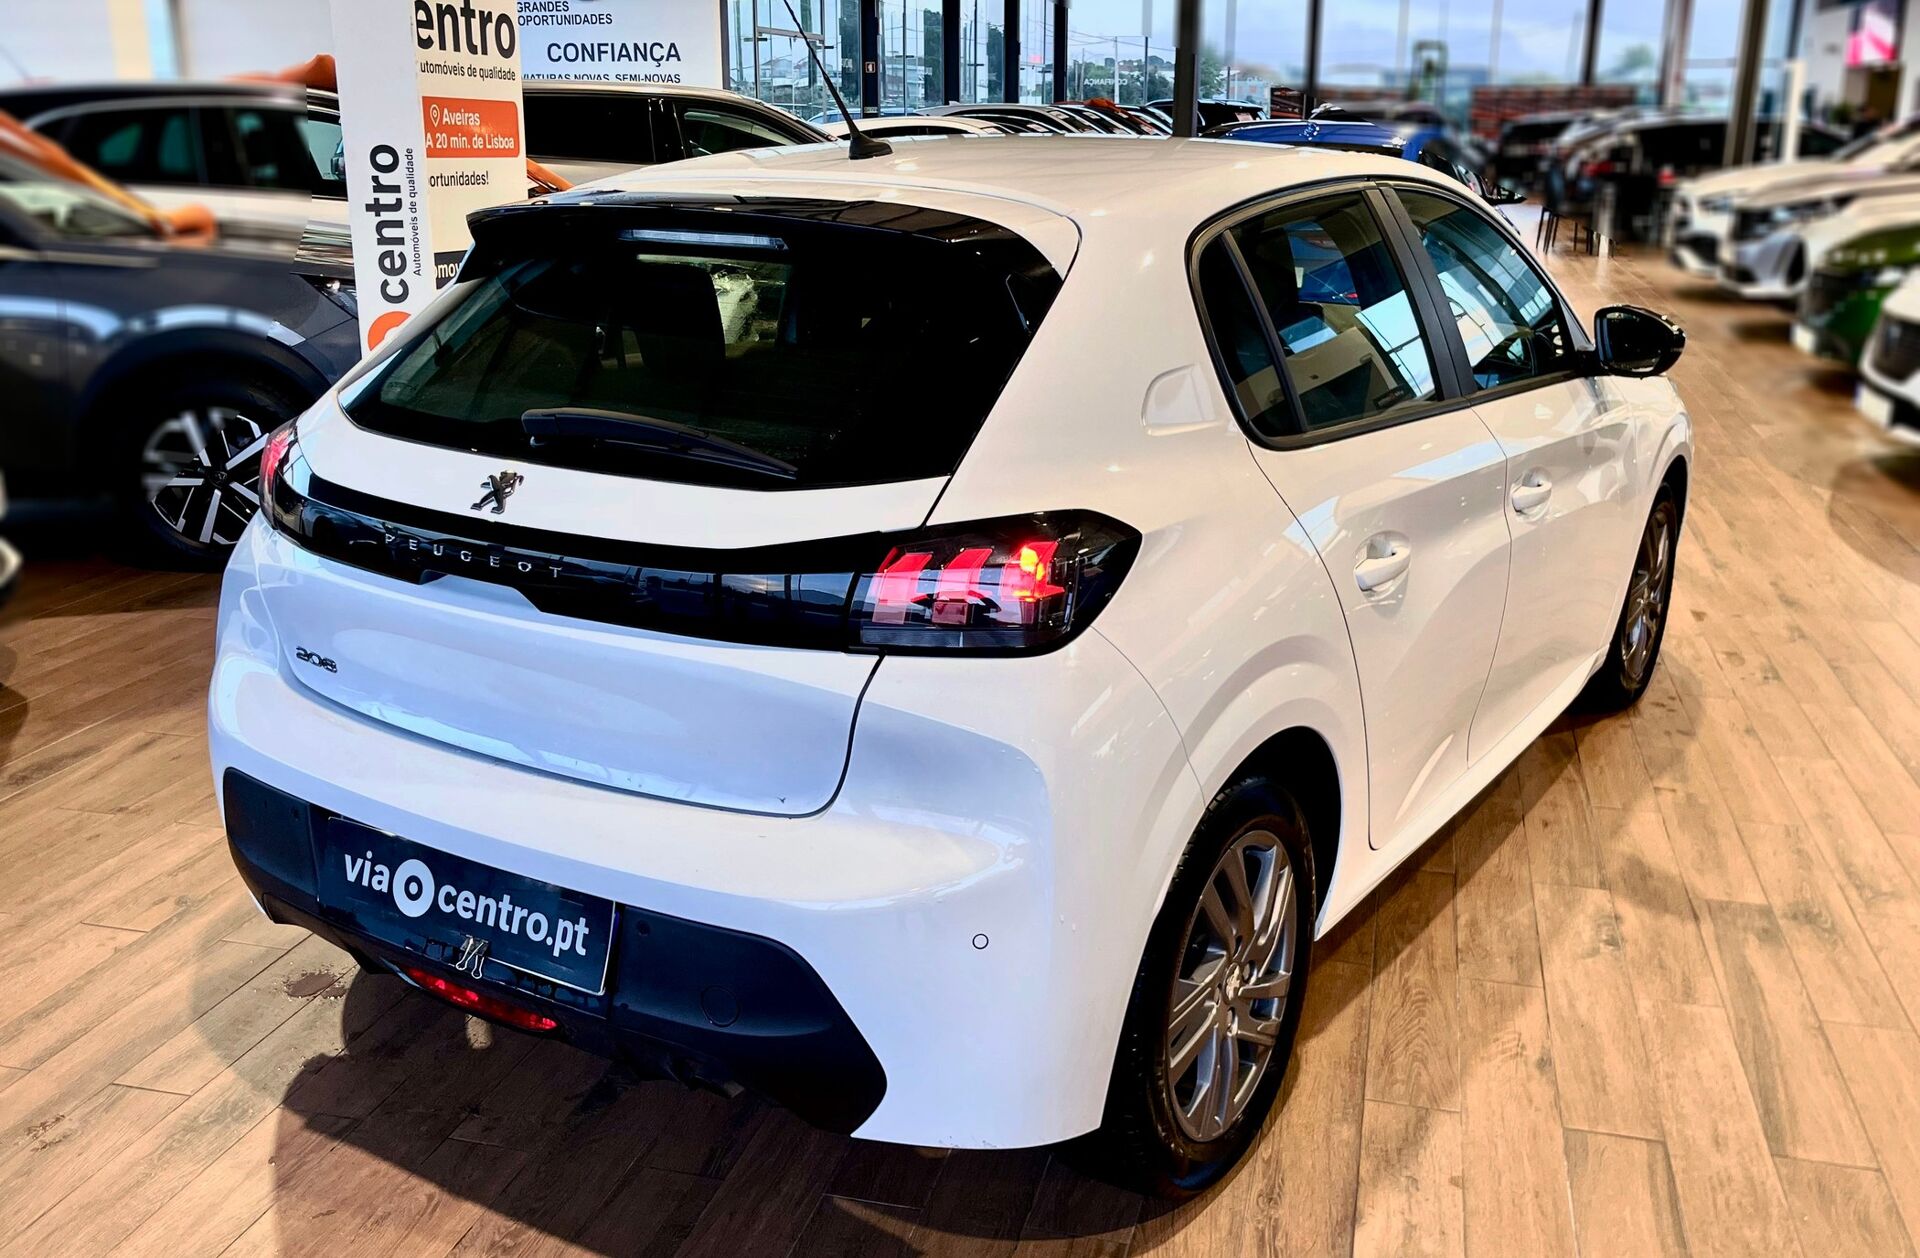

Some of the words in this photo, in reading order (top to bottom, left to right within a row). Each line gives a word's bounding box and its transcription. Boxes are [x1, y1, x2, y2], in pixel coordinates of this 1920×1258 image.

[517, 1, 570, 13] GRANDES
[518, 13, 613, 26] OPORTUNIDADES
[547, 42, 681, 68] CONFIANÇA
[467, 64, 477, 77] de
[479, 66, 516, 81] qualidade
[615, 73, 681, 84] SEMI-NOVAS
[442, 107, 481, 126] Aveiras
[425, 133, 434, 149] A
[435, 133, 448, 149] 20
[450, 133, 471, 149] min.
[472, 133, 484, 149] de
[485, 133, 515, 150] Lisboa
[405, 147, 417, 199] qualidade
[428, 170, 489, 187] ortunidades!
[408, 200, 418, 214] de
[365, 144, 409, 304] centro
[409, 216, 421, 277] Automóveis
[384, 533, 562, 578] PEUGEOT
[296, 646, 337, 673] 208
